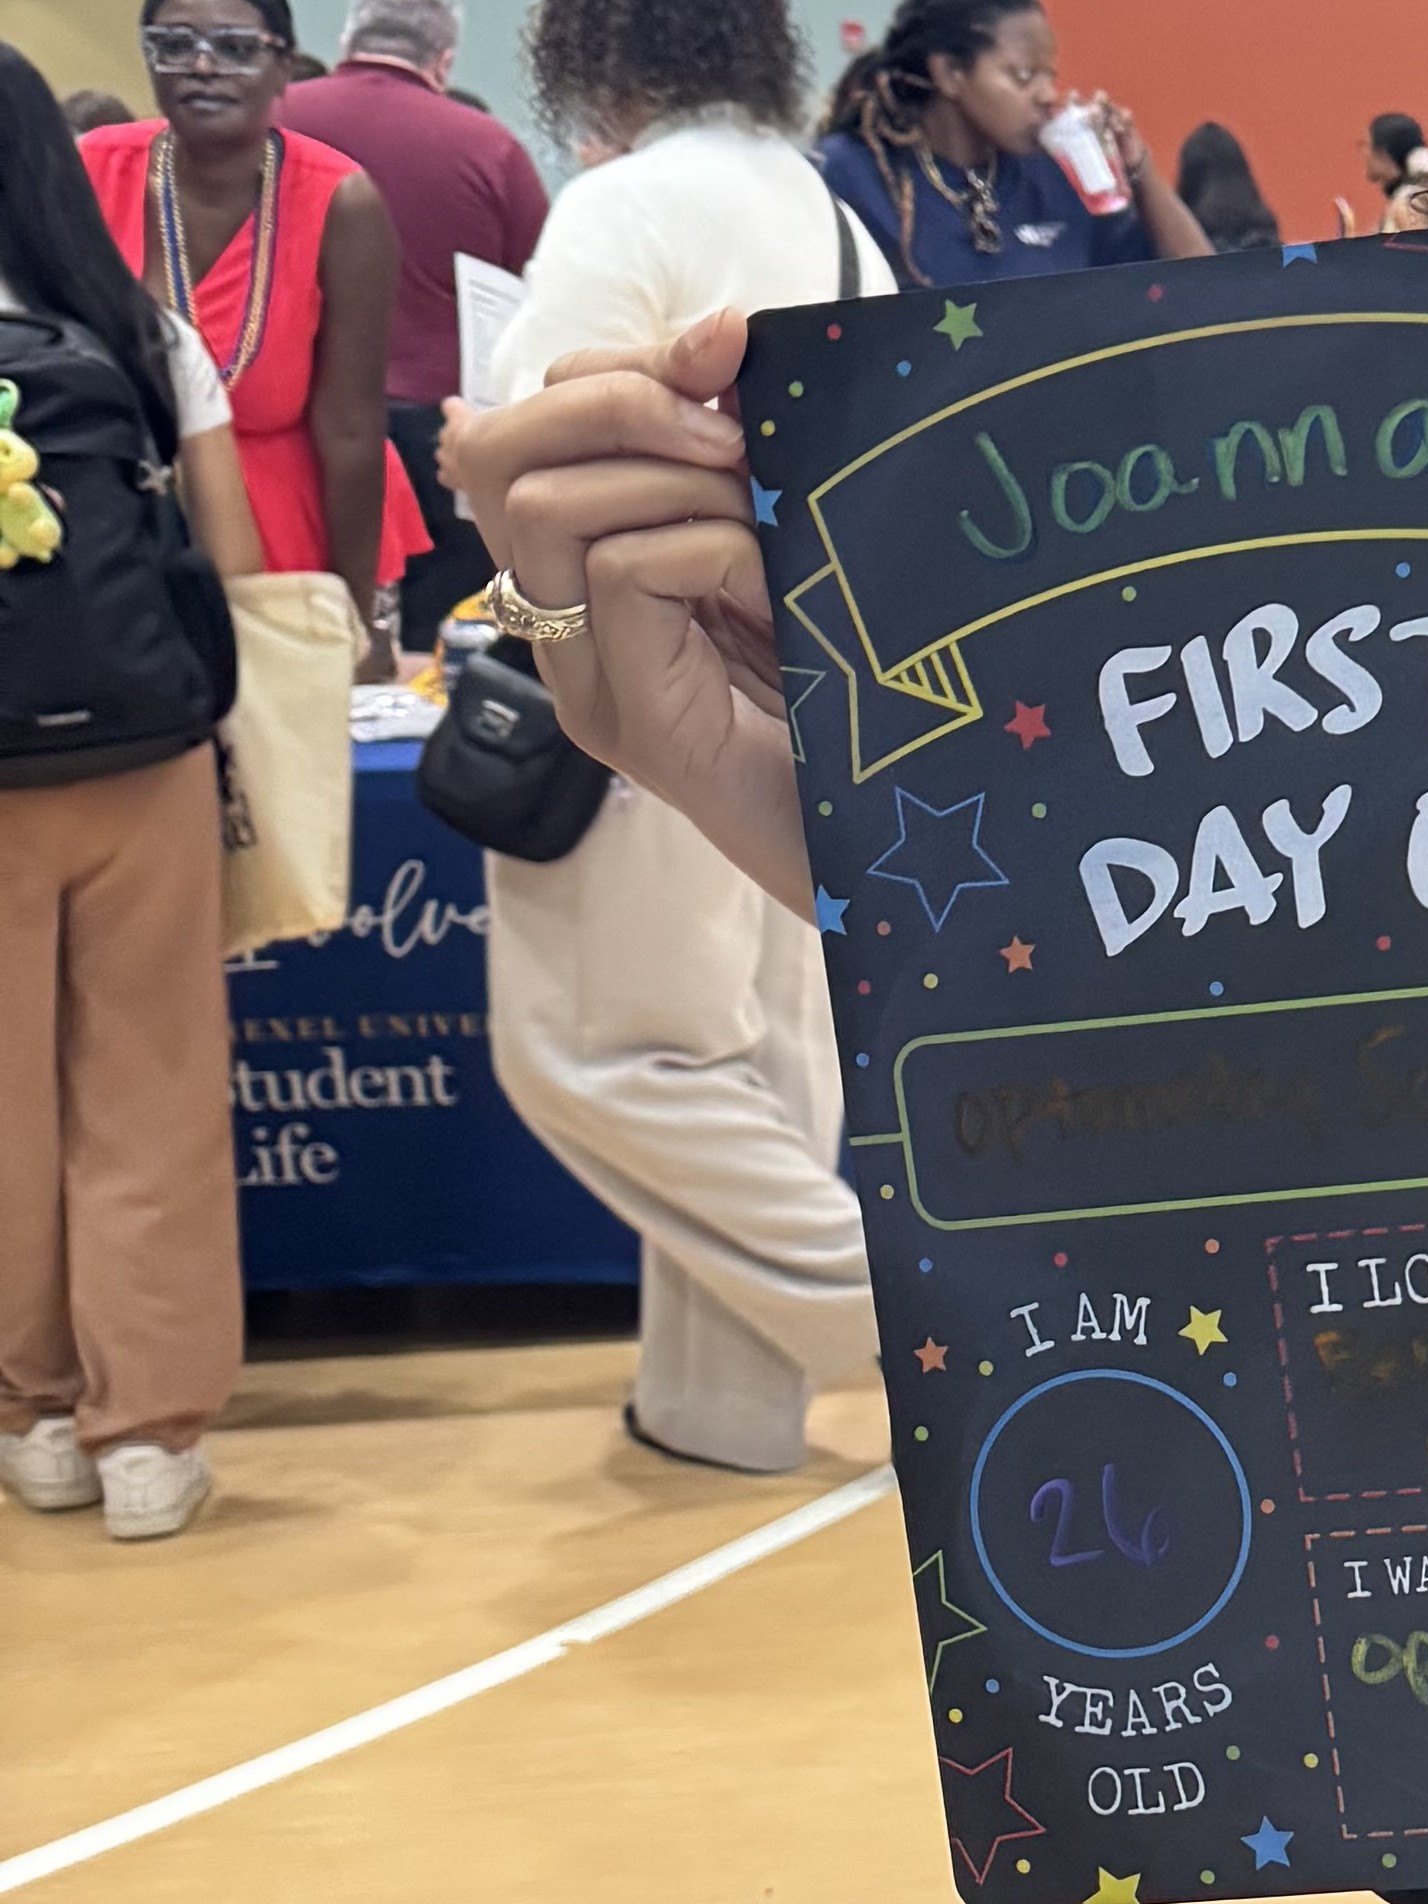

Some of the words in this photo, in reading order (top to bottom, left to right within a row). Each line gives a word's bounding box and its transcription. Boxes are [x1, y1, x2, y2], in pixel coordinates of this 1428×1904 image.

[1078, 783, 1353, 958] DAY
[230, 1045, 459, 1112] tudent
[1304, 1262, 1345, 1315] I
[1009, 1301, 1056, 1358] I
[1070, 1292, 1152, 1347] AM
[1342, 1559, 1372, 1600] I
[1037, 1661, 1234, 1738] YEARS
[1087, 1760, 1207, 1817] OLD
